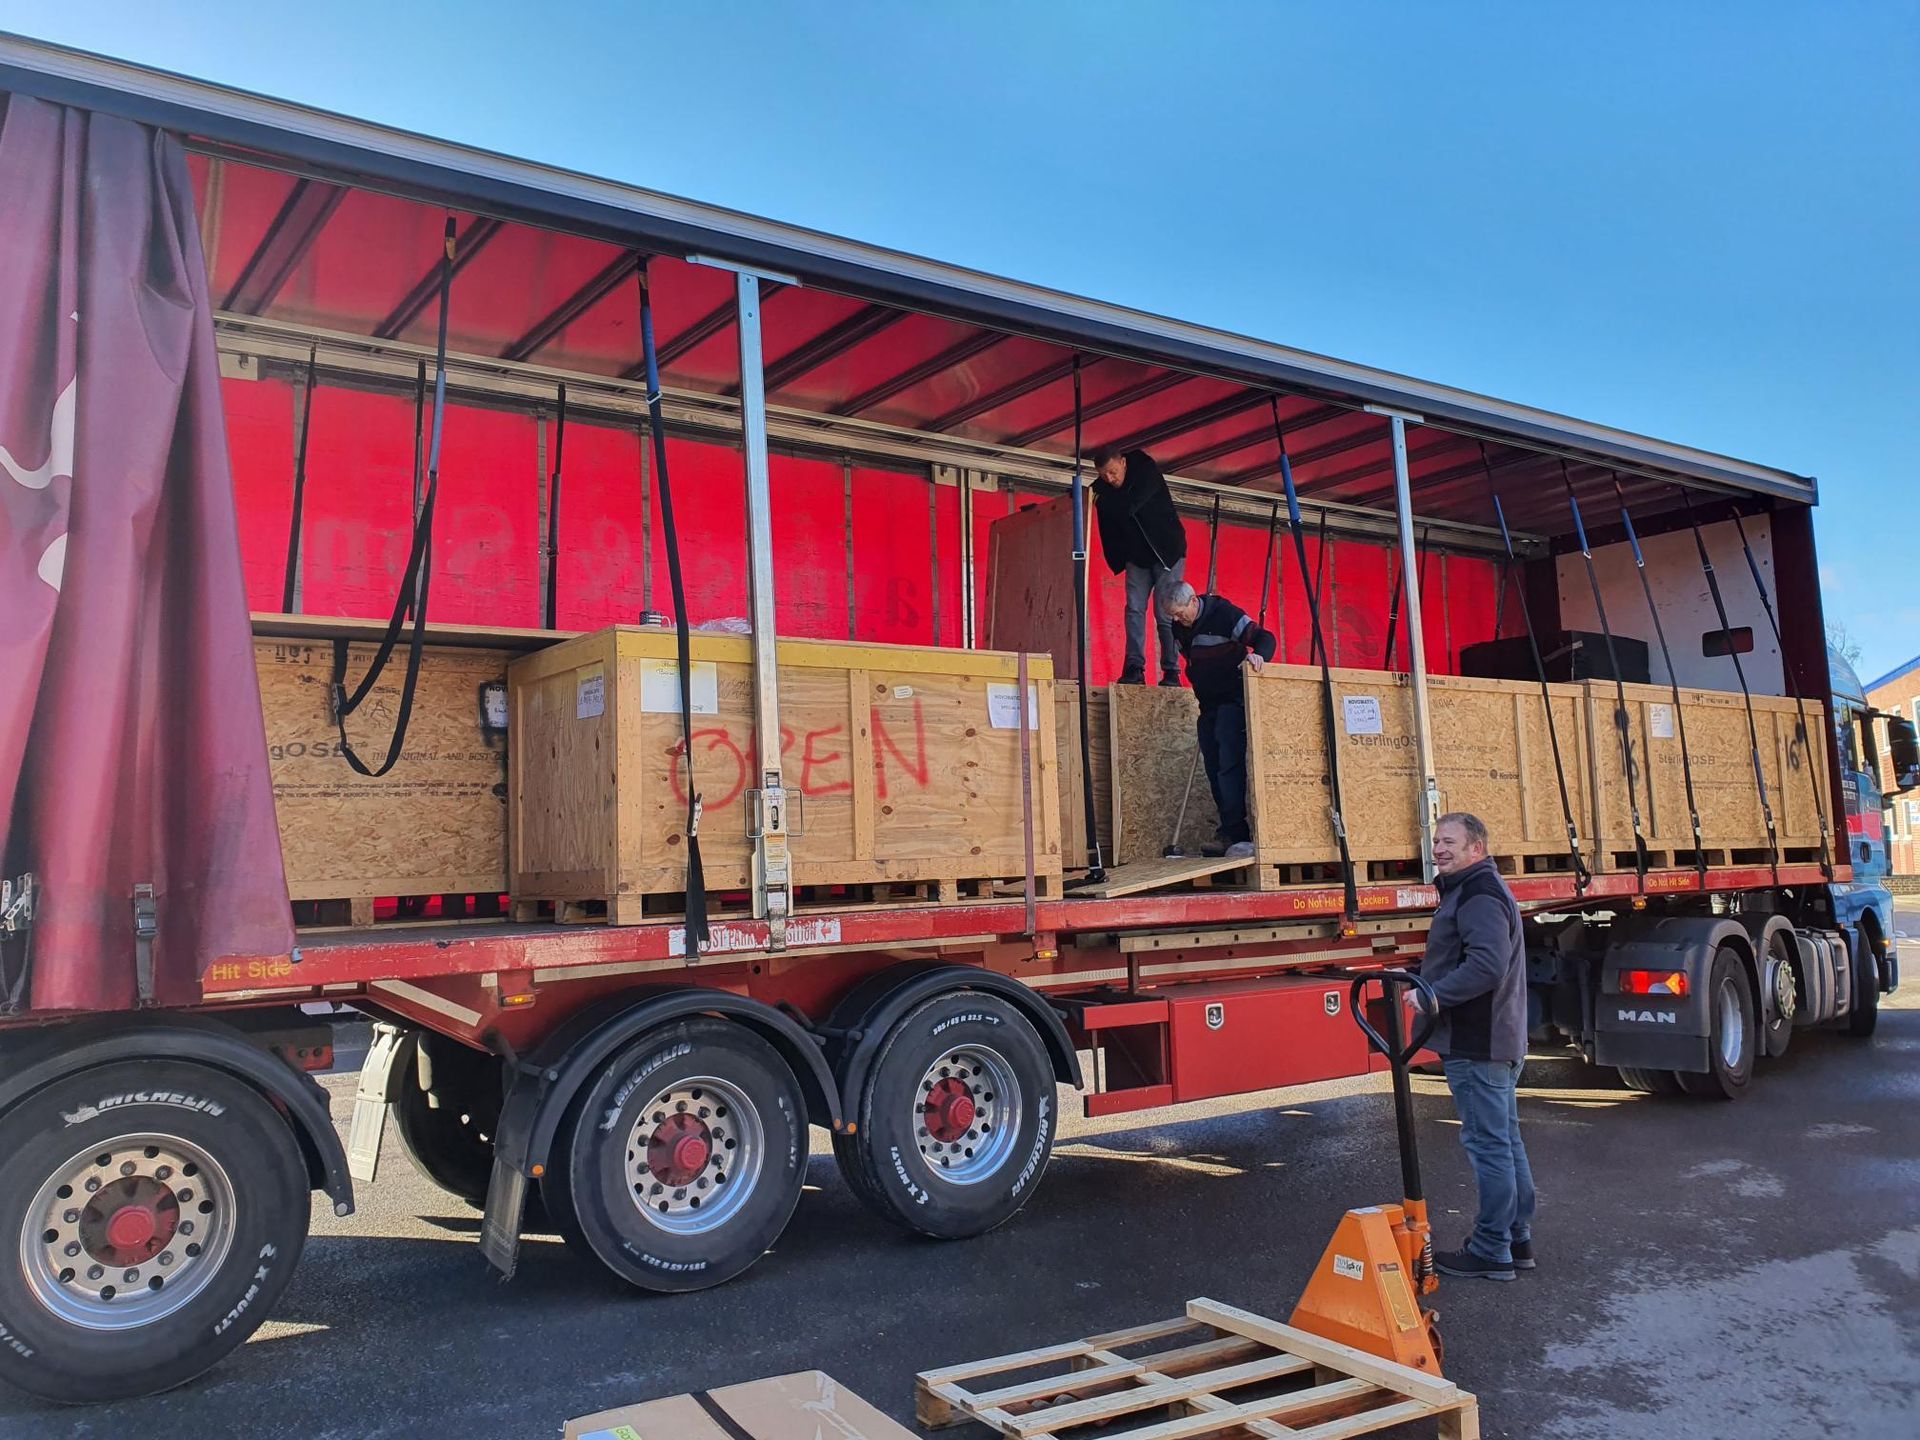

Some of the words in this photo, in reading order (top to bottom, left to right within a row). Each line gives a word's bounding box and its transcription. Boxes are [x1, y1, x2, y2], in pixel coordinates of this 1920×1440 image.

[1350, 733, 1418, 749] SterlingOS
[400, 751, 439, 761] RIGINAL
[669, 699, 931, 812] OPEN
[1293, 898, 1306, 910] Do
[1308, 896, 1323, 908] Not
[1325, 895, 1337, 907] Hit
[1359, 894, 1390, 906] Lockers
[212, 963, 241, 981] Hit
[247, 960, 292, 979] Side
[1617, 1009, 1676, 1024] MAN
[613, 1042, 693, 1107] MICHELIN
[98, 1088, 228, 1117] MICHELIN
[890, 1146, 911, 1185] MULTI
[1011, 1118, 1050, 1198] MICHELIN
[907, 1182, 919, 1197] X
[214, 1284, 260, 1336] MULTI
